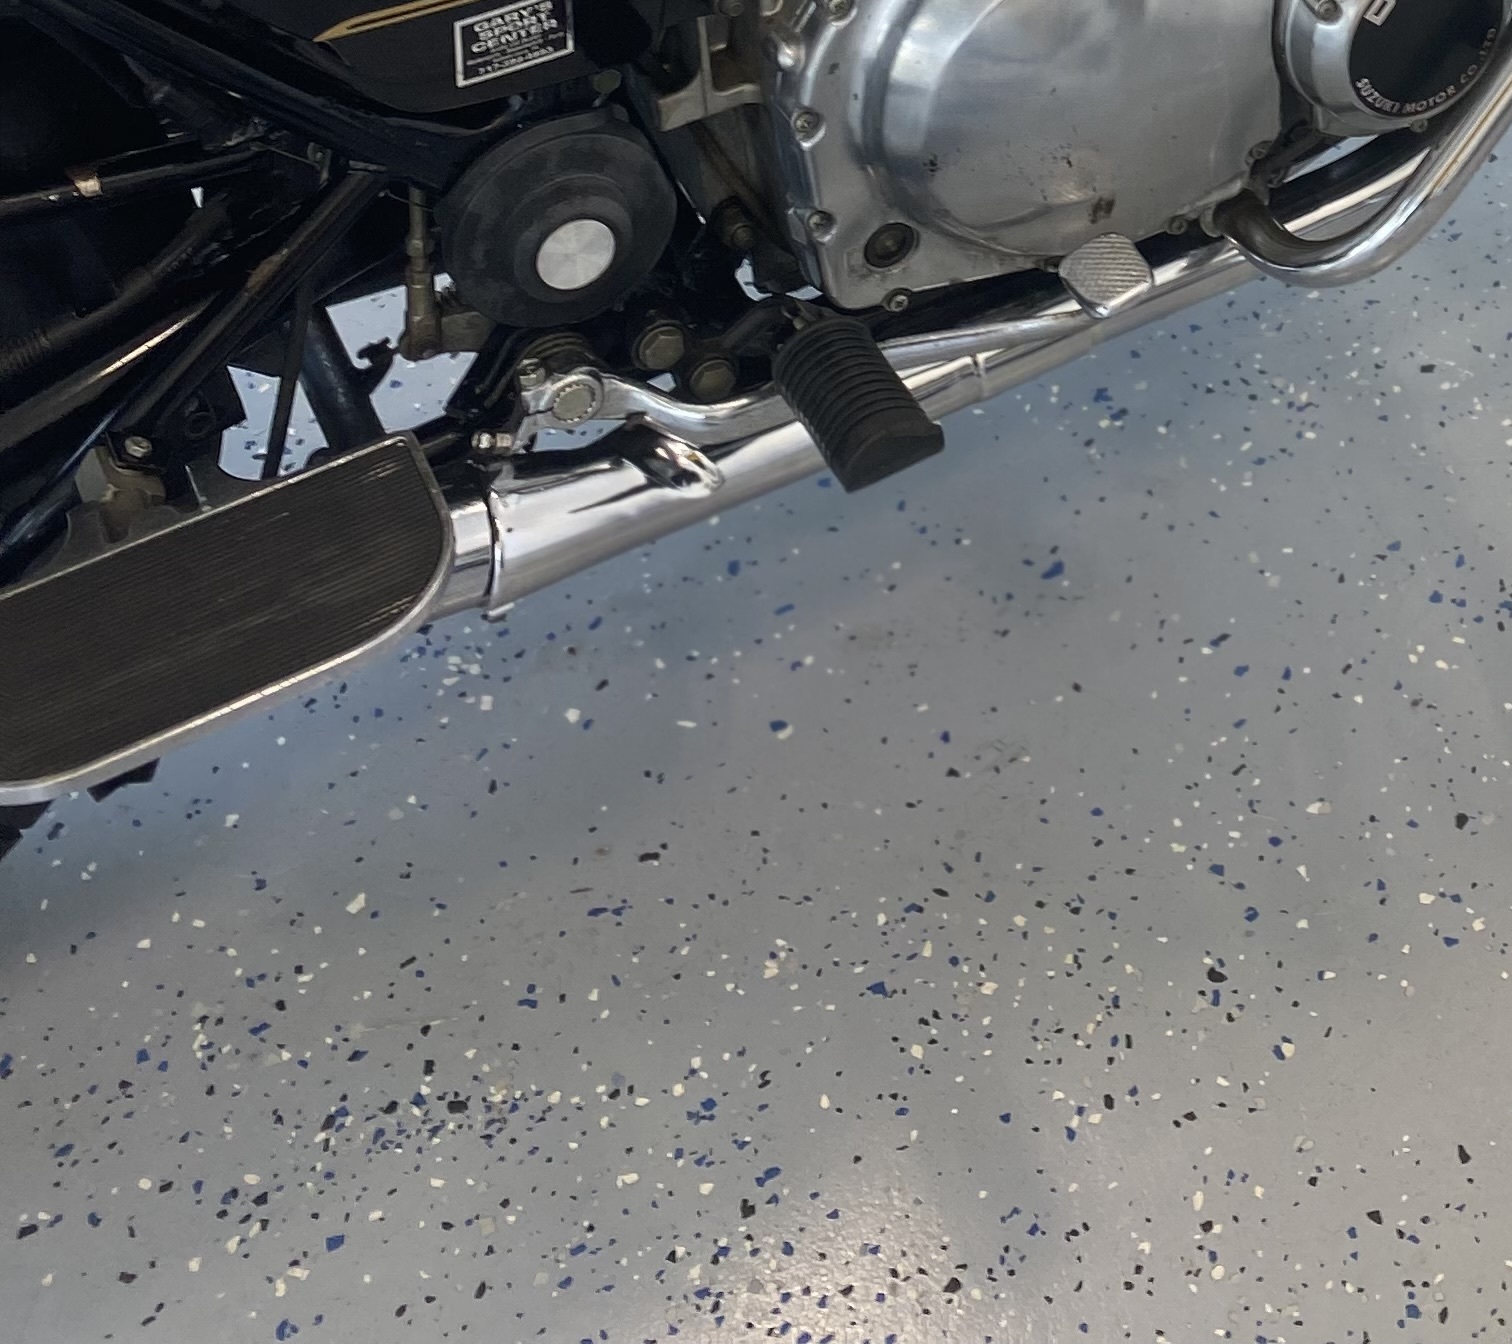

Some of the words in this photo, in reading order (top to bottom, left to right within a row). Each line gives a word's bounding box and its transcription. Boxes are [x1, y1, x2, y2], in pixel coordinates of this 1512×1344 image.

[471, 19, 558, 53] CENTER
[1354, 77, 1401, 113] SUZUKI
[1401, 84, 1457, 114] MOTOR
